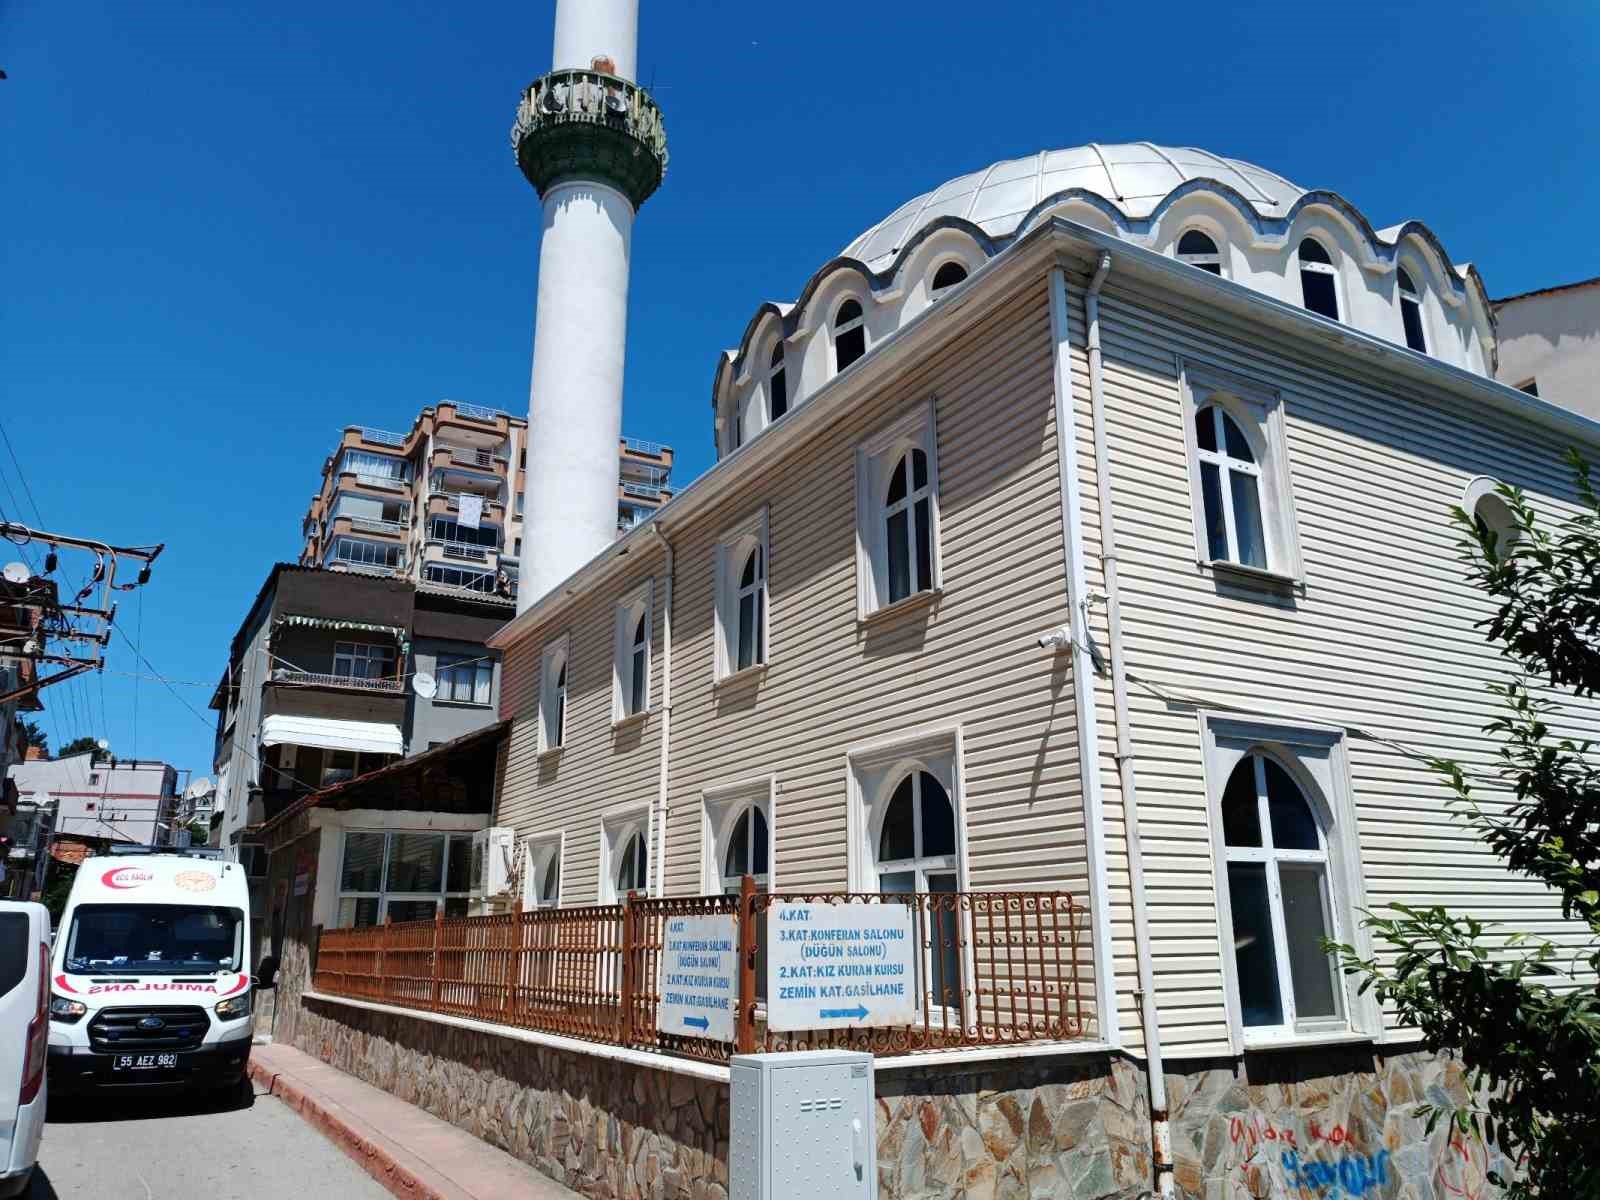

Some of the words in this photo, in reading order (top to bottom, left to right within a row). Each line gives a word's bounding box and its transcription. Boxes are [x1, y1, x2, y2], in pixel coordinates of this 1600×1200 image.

[863, 928, 904, 940] SALONU
[847, 941, 887, 960] SALONU)
[838, 964, 872, 977] KURAN
[874, 963, 904, 976] KURSU
[779, 984, 816, 999] ZEMİN
[120, 1055, 132, 1067] 55
[136, 1055, 154, 1066] AEZ
[157, 1054, 176, 1065] 982
